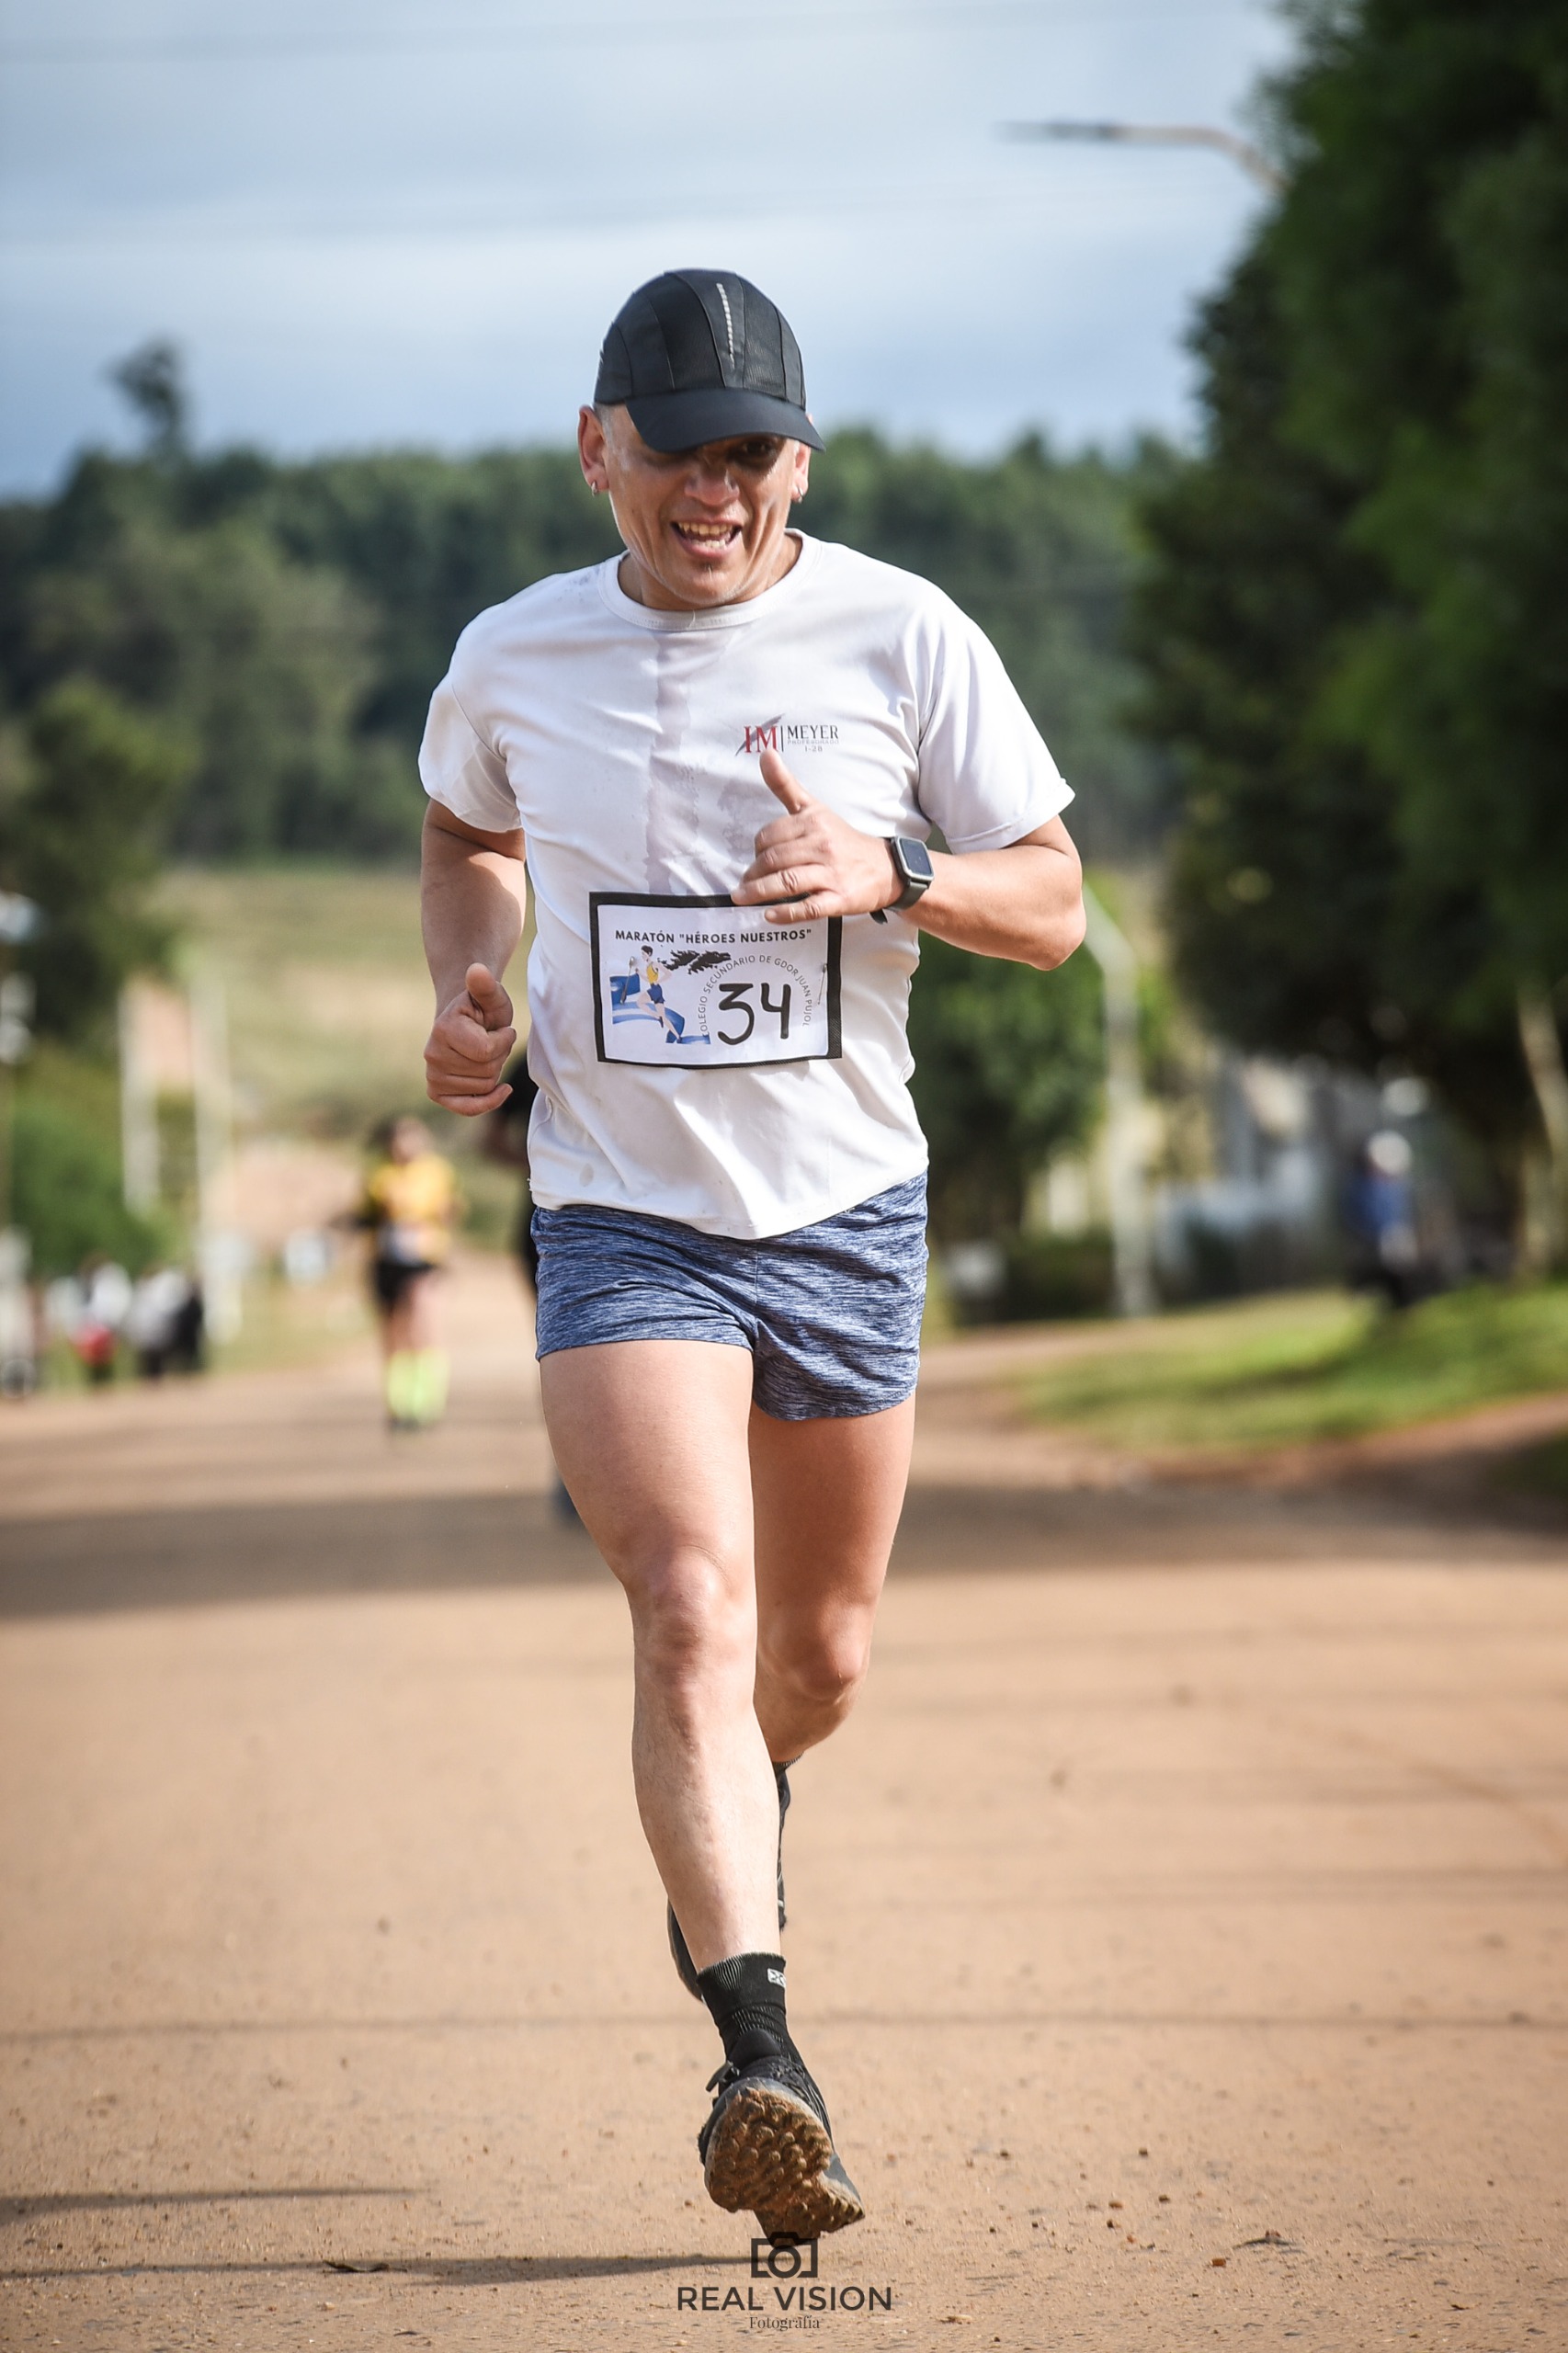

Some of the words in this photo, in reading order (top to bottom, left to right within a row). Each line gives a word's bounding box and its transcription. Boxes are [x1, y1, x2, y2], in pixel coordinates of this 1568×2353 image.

[787, 724, 839, 739] MEYER
[615, 929, 675, 943] MARATÓN
[679, 931, 735, 944] "HÉROES
[740, 928, 812, 943] NUESTROS"
[759, 954, 772, 963] DE
[774, 958, 799, 977] GDOR
[704, 955, 756, 994] SECUNDARIO
[795, 974, 811, 998] JUAN
[718, 983, 791, 1045] 34
[802, 999, 812, 1028] PUJOL
